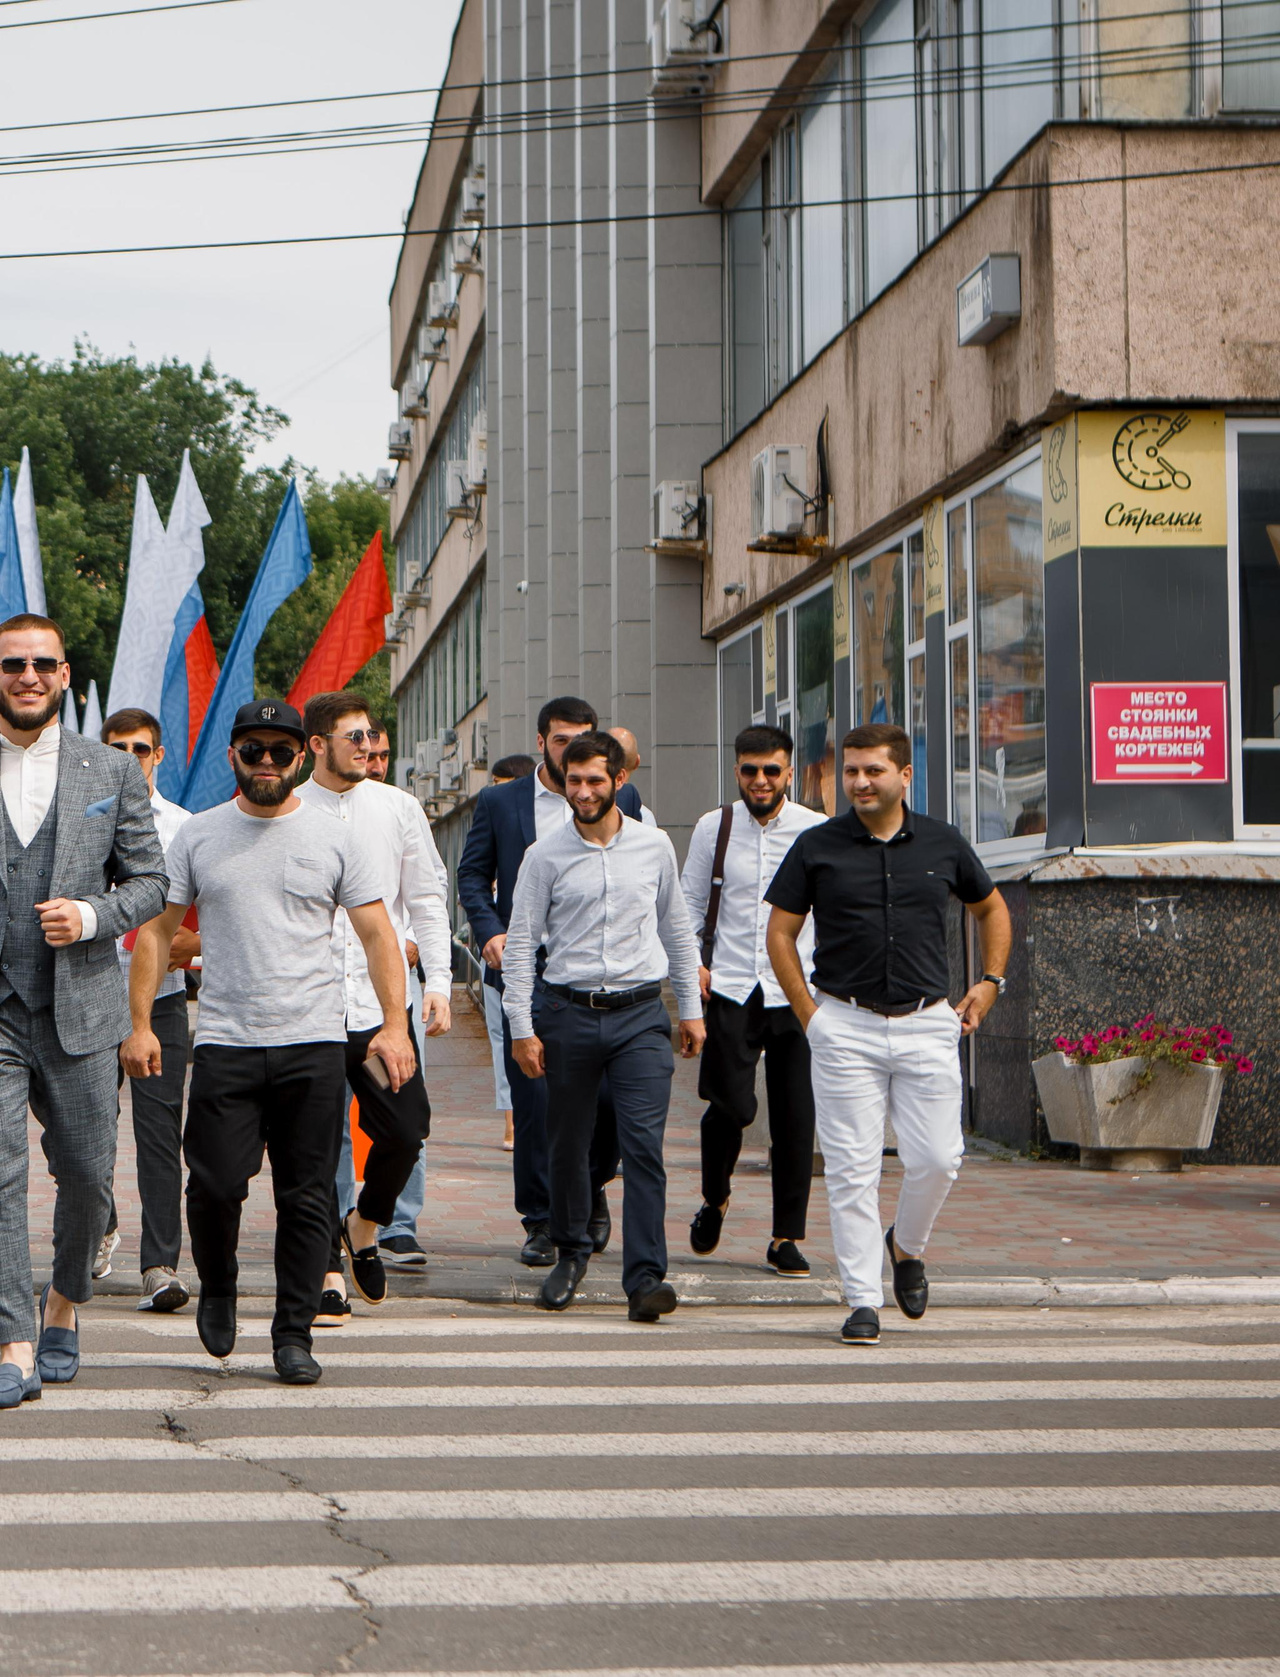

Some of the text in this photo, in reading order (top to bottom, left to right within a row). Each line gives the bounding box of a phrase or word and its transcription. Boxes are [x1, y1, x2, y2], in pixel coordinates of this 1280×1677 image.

[1105, 502, 1202, 534] Стрелки
[1130, 691, 1187, 705] МЕСТО
[1120, 708, 1197, 722] СТОЯНКИ
[1107, 725, 1211, 741] СВАДЕБНЫХ
[1115, 741, 1205, 757] КОРТЕЖЕЙ
